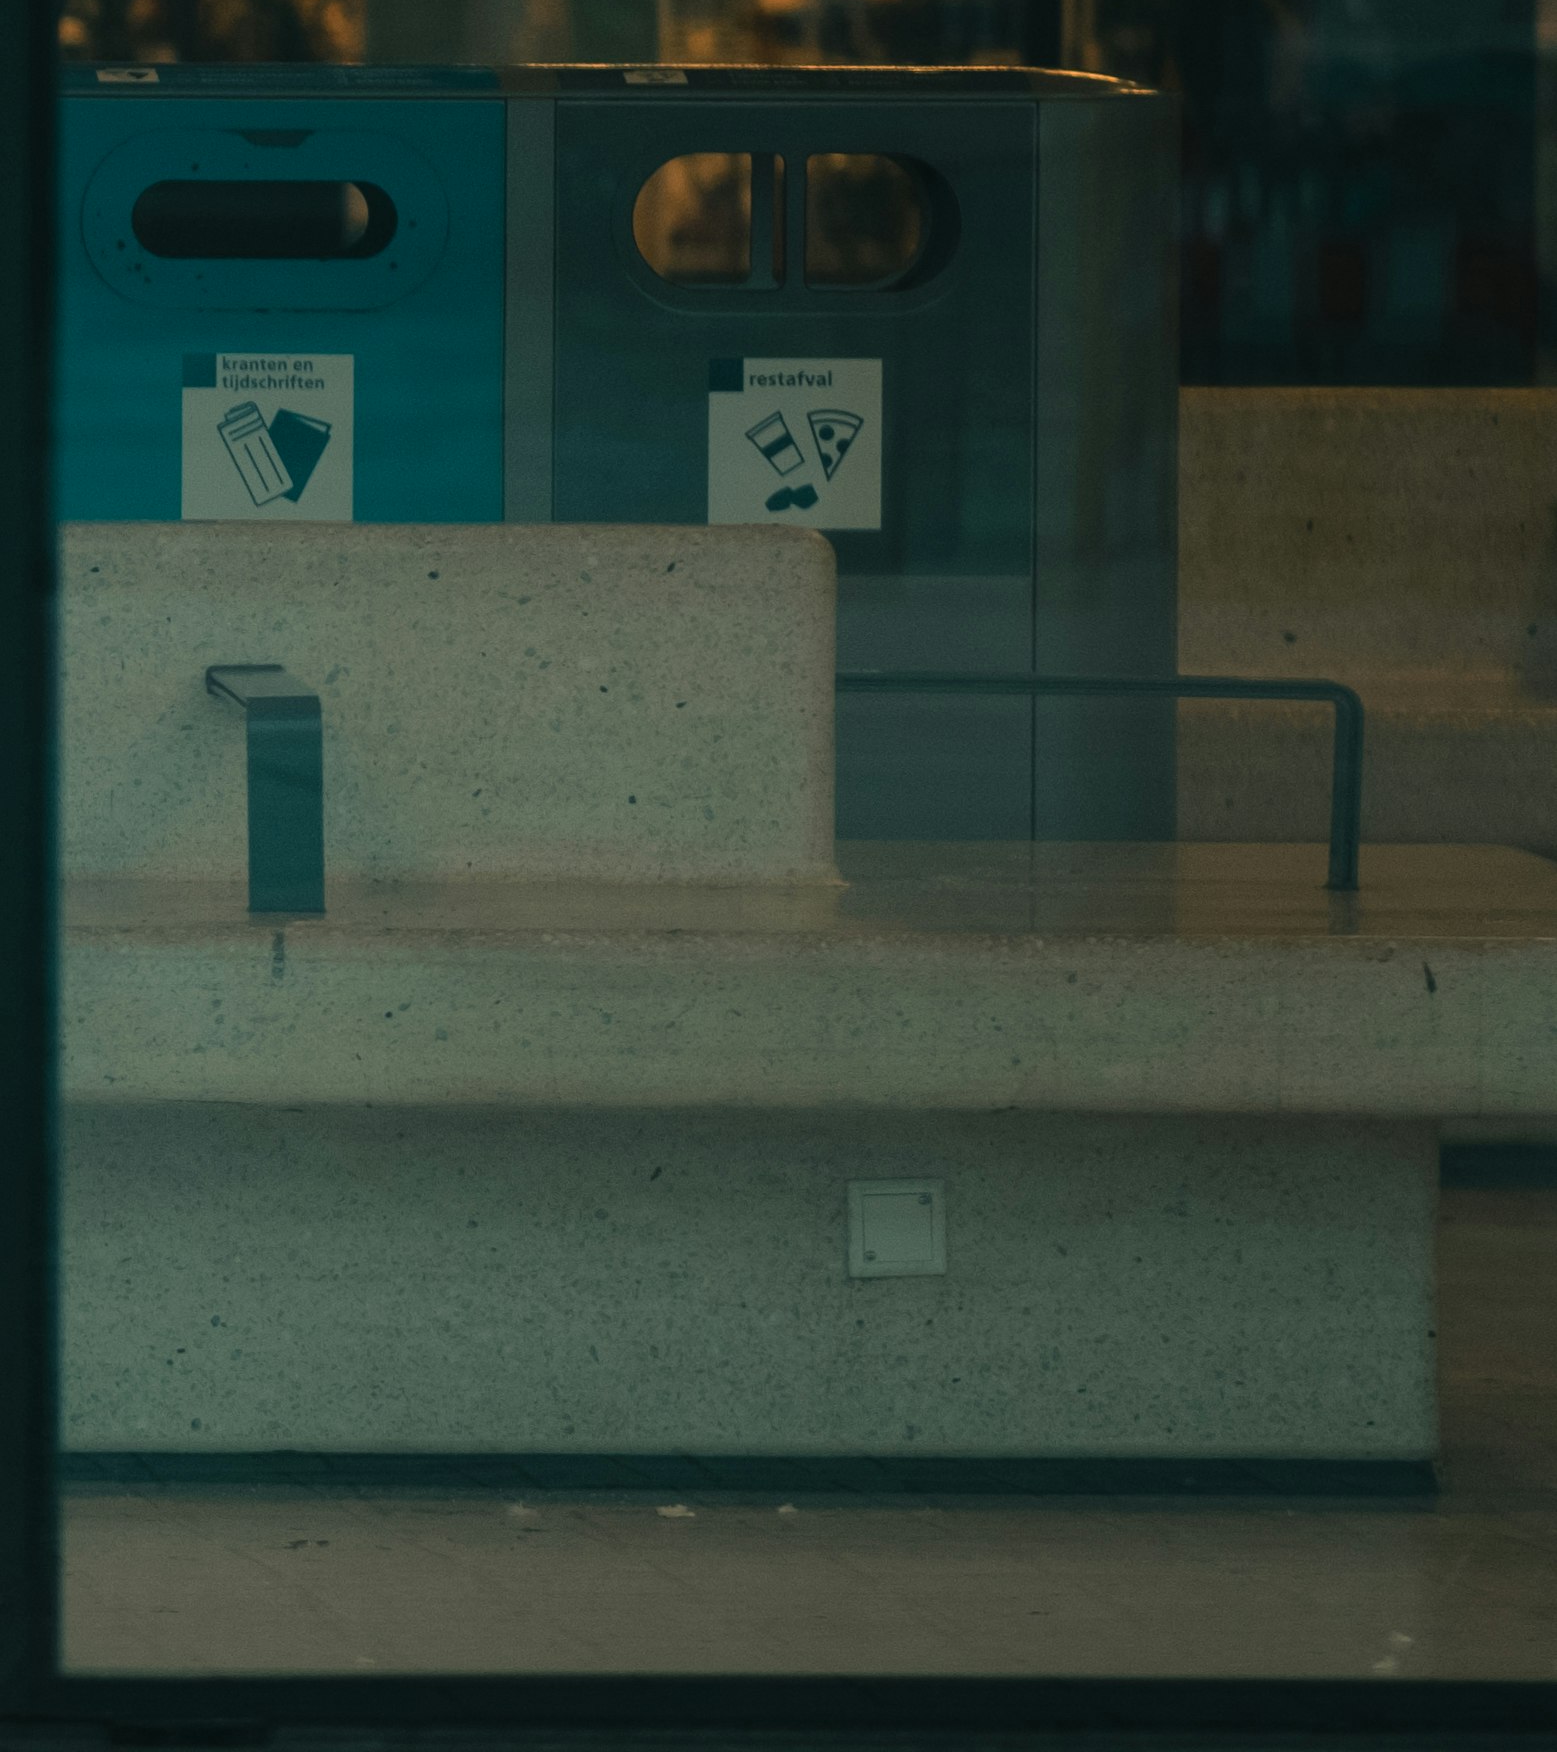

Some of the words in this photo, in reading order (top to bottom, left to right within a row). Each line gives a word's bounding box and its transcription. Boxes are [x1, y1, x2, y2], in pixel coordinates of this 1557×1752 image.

[222, 356, 288, 371] kranten
[293, 360, 314, 372] en
[222, 374, 325, 391] tijdschriften
[749, 370, 833, 386] restafval
